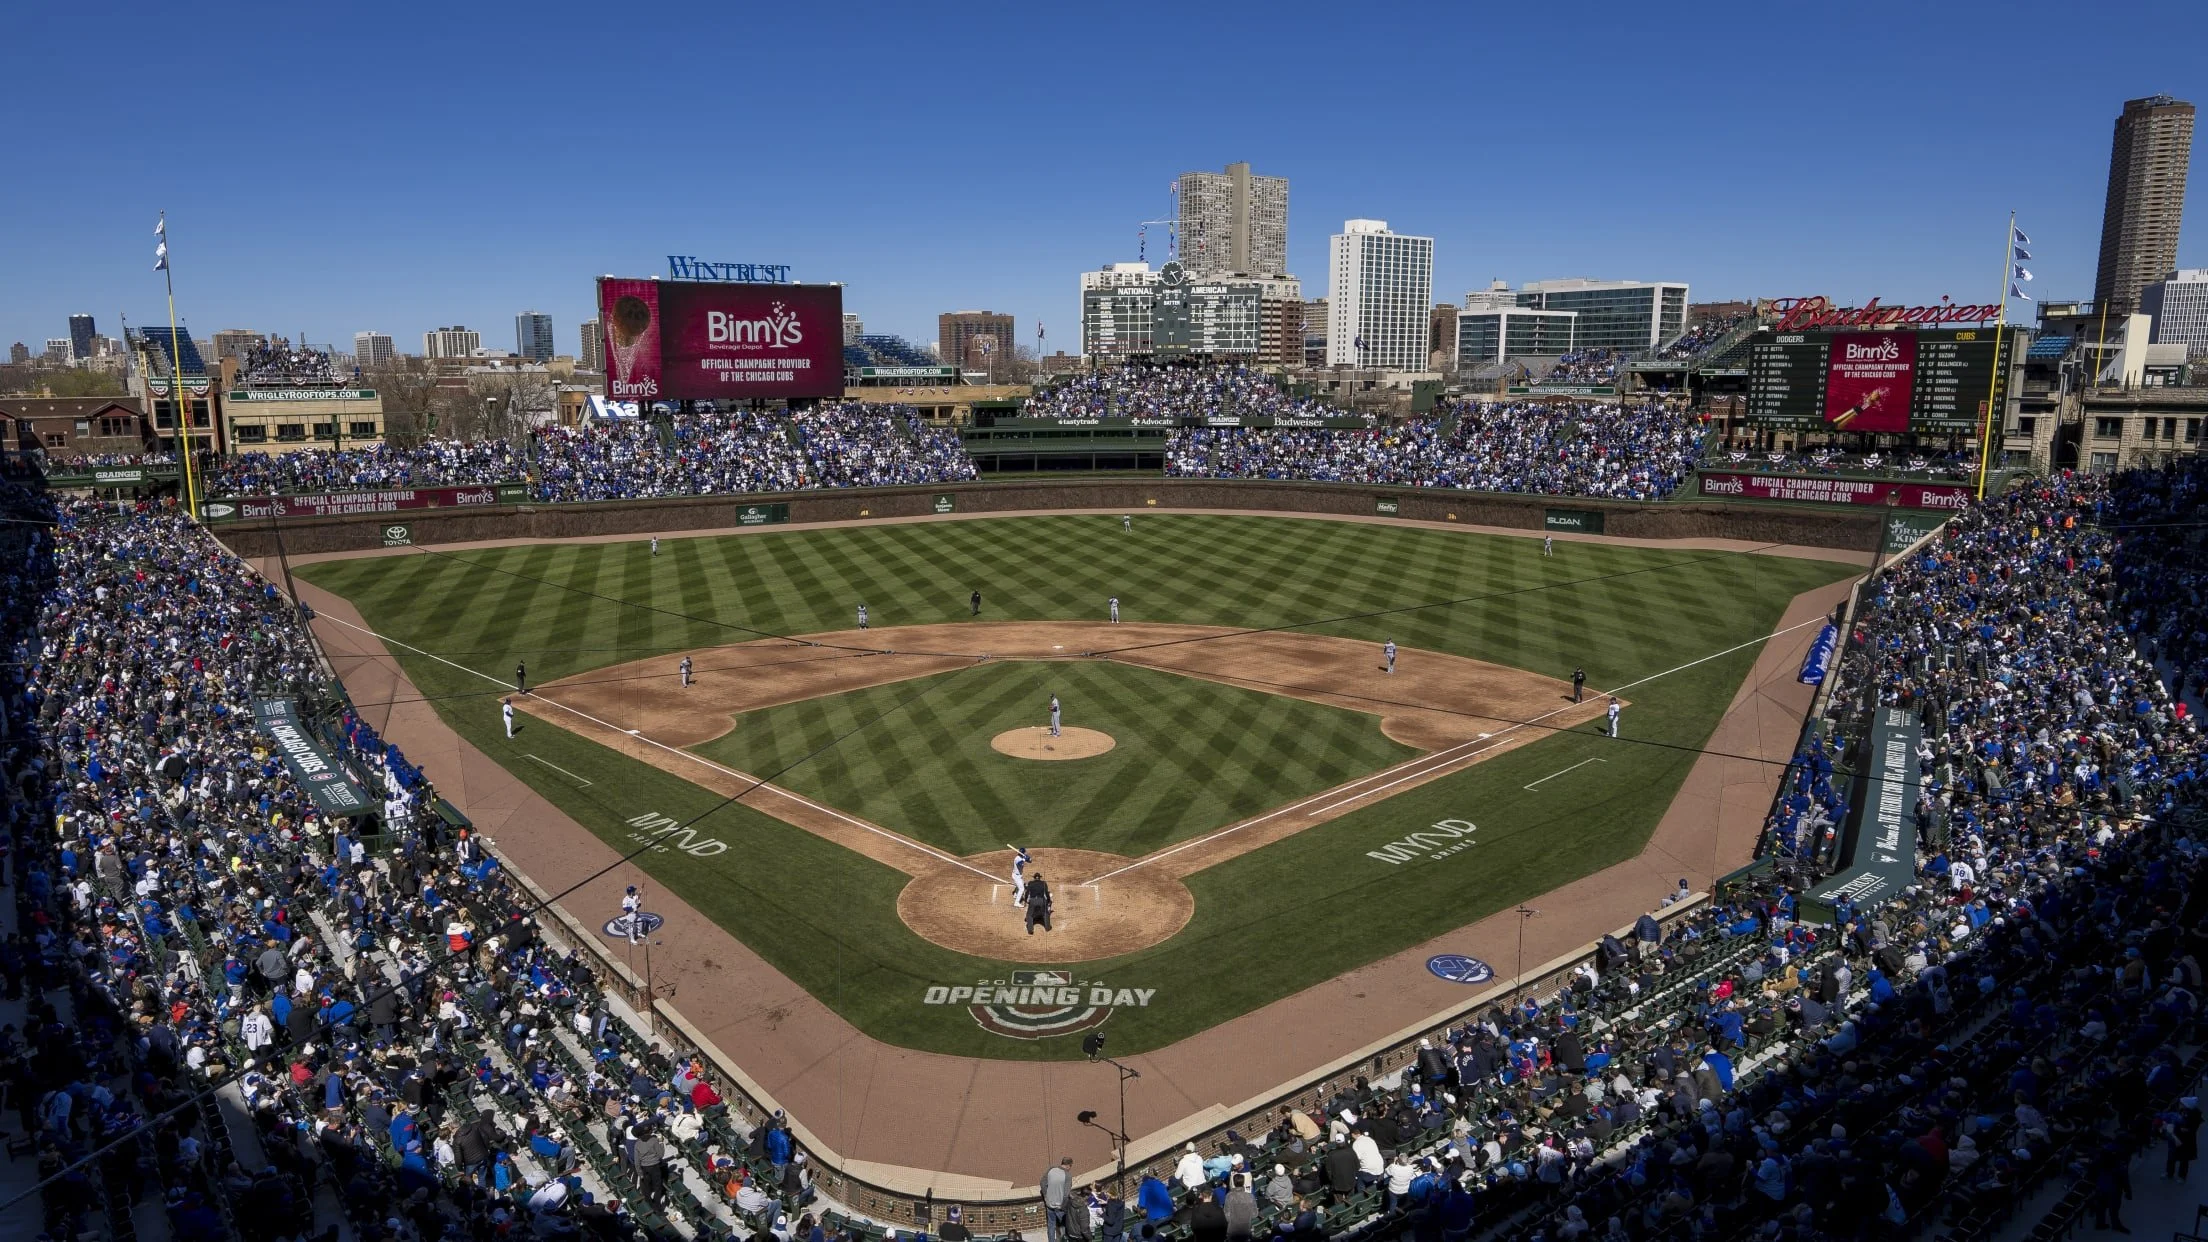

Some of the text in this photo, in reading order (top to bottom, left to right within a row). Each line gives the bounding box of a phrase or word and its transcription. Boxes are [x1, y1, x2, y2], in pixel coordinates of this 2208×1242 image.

[667, 255, 790, 282] WINTRUST
[1771, 295, 2003, 332] Budweiser
[701, 359, 811, 369] OFFICIAL CHAMPAGNE PROVIDER
[721, 372, 794, 382] OF THE CHICAGO CUBS
[1274, 417, 1323, 427] Budweiser
[96, 470, 141, 478] GRAINGER
[1752, 477, 1873, 494] OFFICIAL CHAMPAGNE PROVIDER
[294, 491, 415, 506] OFFICIAL CHAMPAGNE PROVIDER
[1770, 487, 1852, 502] OF THE CHICAGO CUBS
[316, 501, 396, 515] OF THE CHICAGO CUBS
[1547, 516, 1581, 526] SLOAN
[271, 725, 328, 774] CHICAGO CUBS
[625, 812, 728, 856] MYND
[1366, 820, 1476, 864] MYND
[1430, 840, 1476, 860] DRINKS
[924, 986, 1156, 1006] OPENING DAY
[247, 1024, 257, 1033] 23
